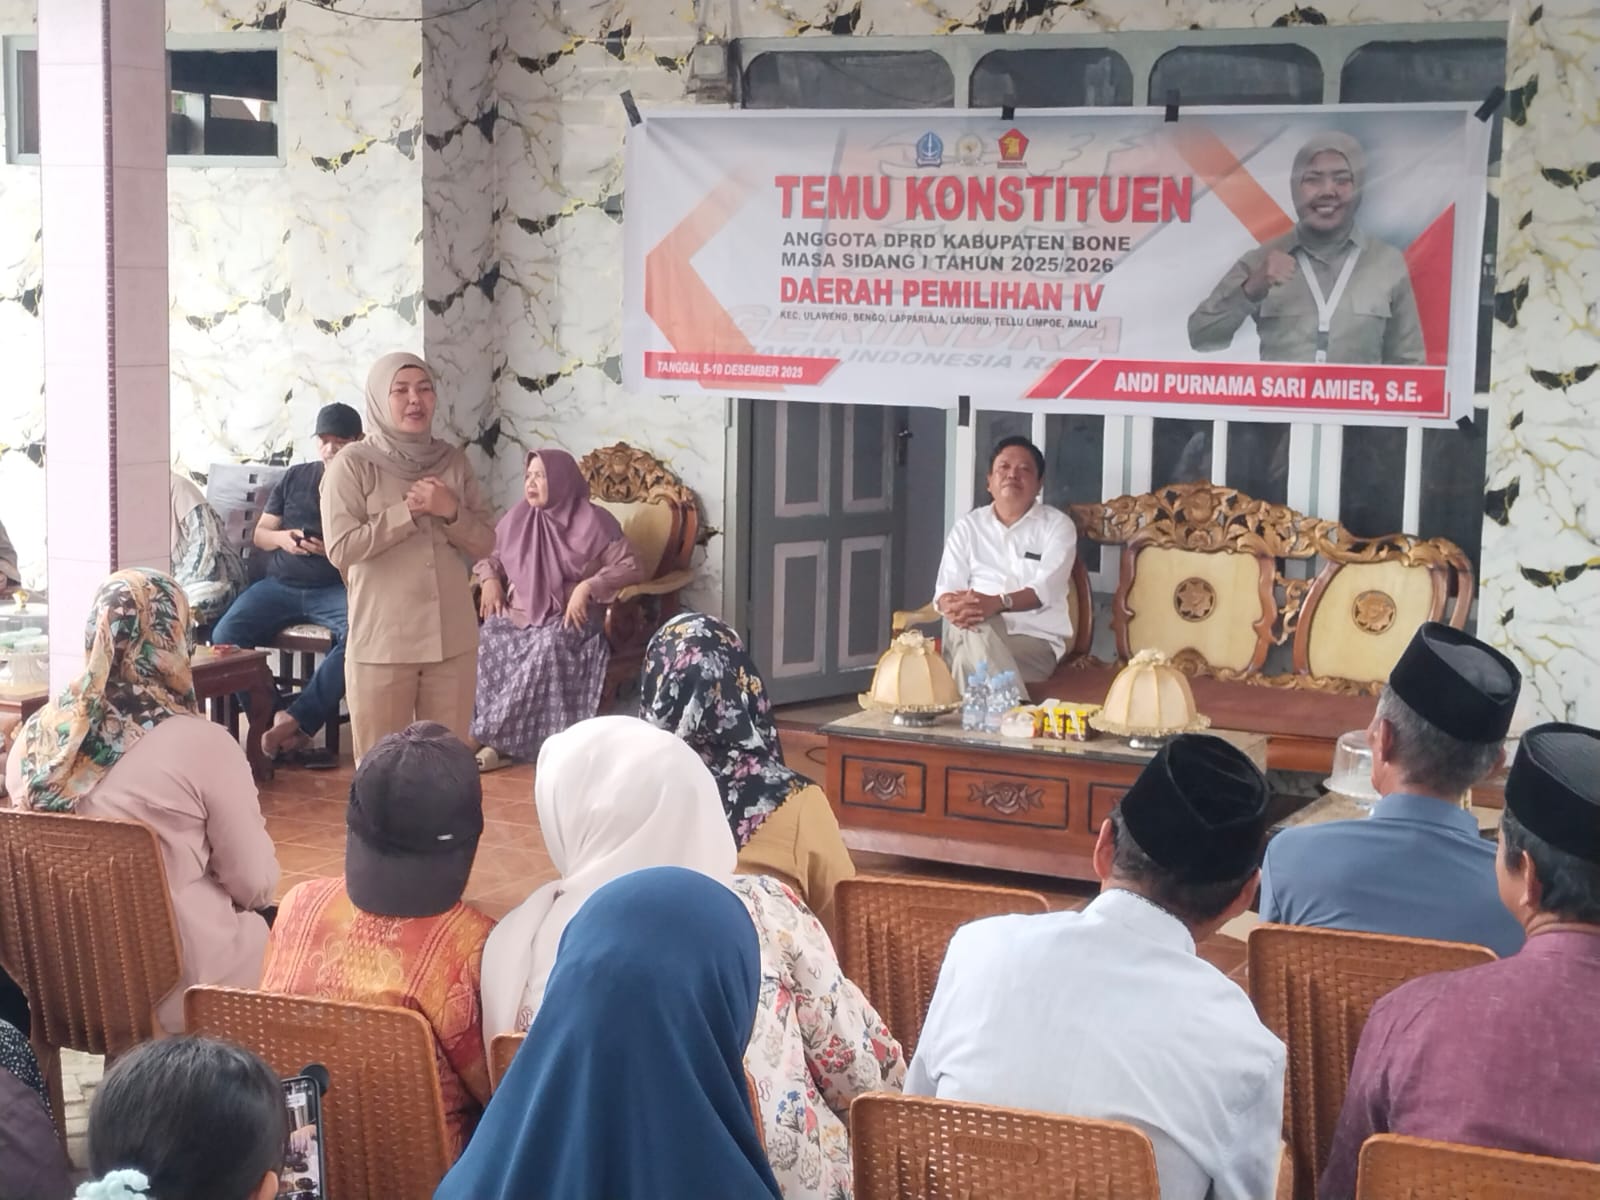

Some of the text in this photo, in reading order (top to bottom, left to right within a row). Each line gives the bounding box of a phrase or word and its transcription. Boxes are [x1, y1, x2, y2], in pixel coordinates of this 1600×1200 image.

[775, 176, 1193, 223] TEMU KONSTITUEN
[783, 232, 1131, 251] ANGGOTA DPRD KABUPATEN BONE
[781, 252, 1114, 273] MASA SIDANG I TAHUN 2025/2026
[780, 277, 1105, 312] DAERAH PEMILIHAN IV
[950, 315, 992, 327] LAMURU,
[995, 317, 1023, 327] TELLU
[1026, 318, 1065, 329] LIMPOE,
[1067, 319, 1098, 329] AMALI
[657, 360, 803, 379] TANGGAL 5-10 DESEMBER 2025
[848, 350, 1013, 369] INDONESIA
[1114, 371, 1422, 405] ANDI PURNAMA SARI AMIER, S.E.
